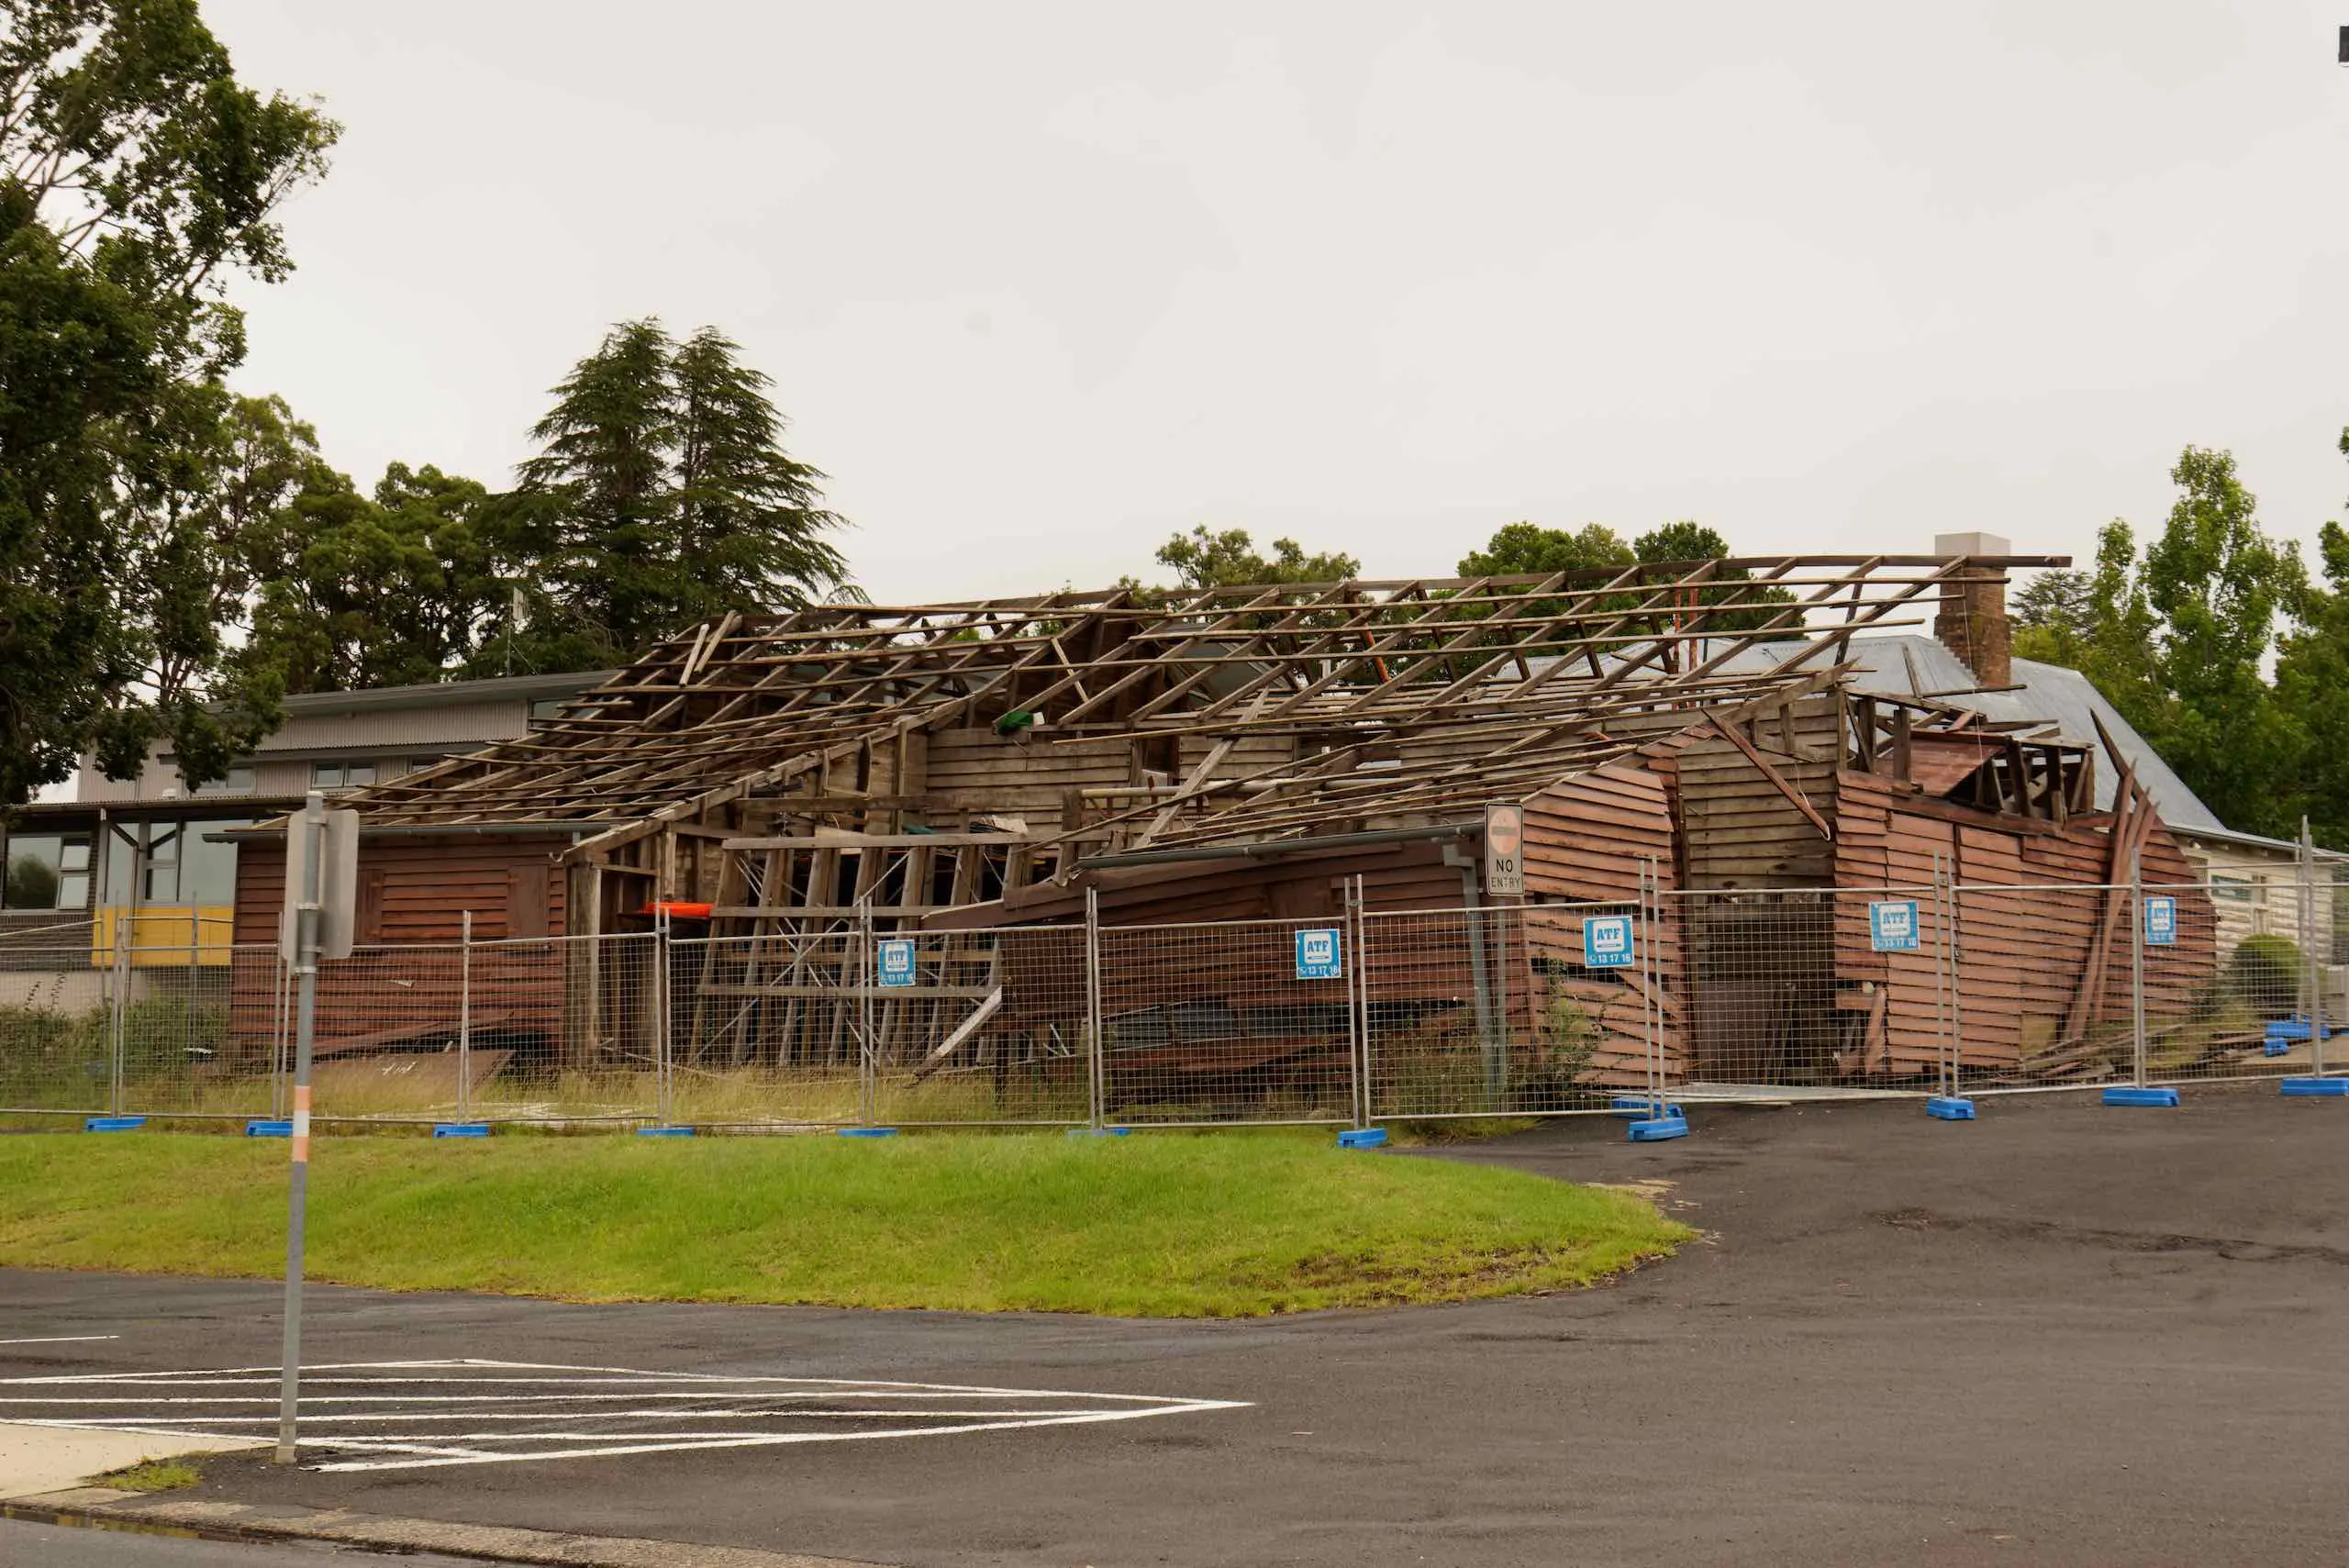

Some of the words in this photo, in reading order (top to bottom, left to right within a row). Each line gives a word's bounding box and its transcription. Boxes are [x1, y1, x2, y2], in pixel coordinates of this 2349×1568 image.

[1496, 858, 1513, 873] NO
[1491, 876, 1520, 888] ENTRY
[1883, 912, 1907, 924] ATF
[1597, 928, 1620, 940] ATF
[1307, 940, 1329, 952] ATF
[1598, 954, 1608, 963] 13
[1609, 954, 1619, 962] 17
[1308, 966, 1317, 976] 13
[1319, 965, 1328, 976] 17
